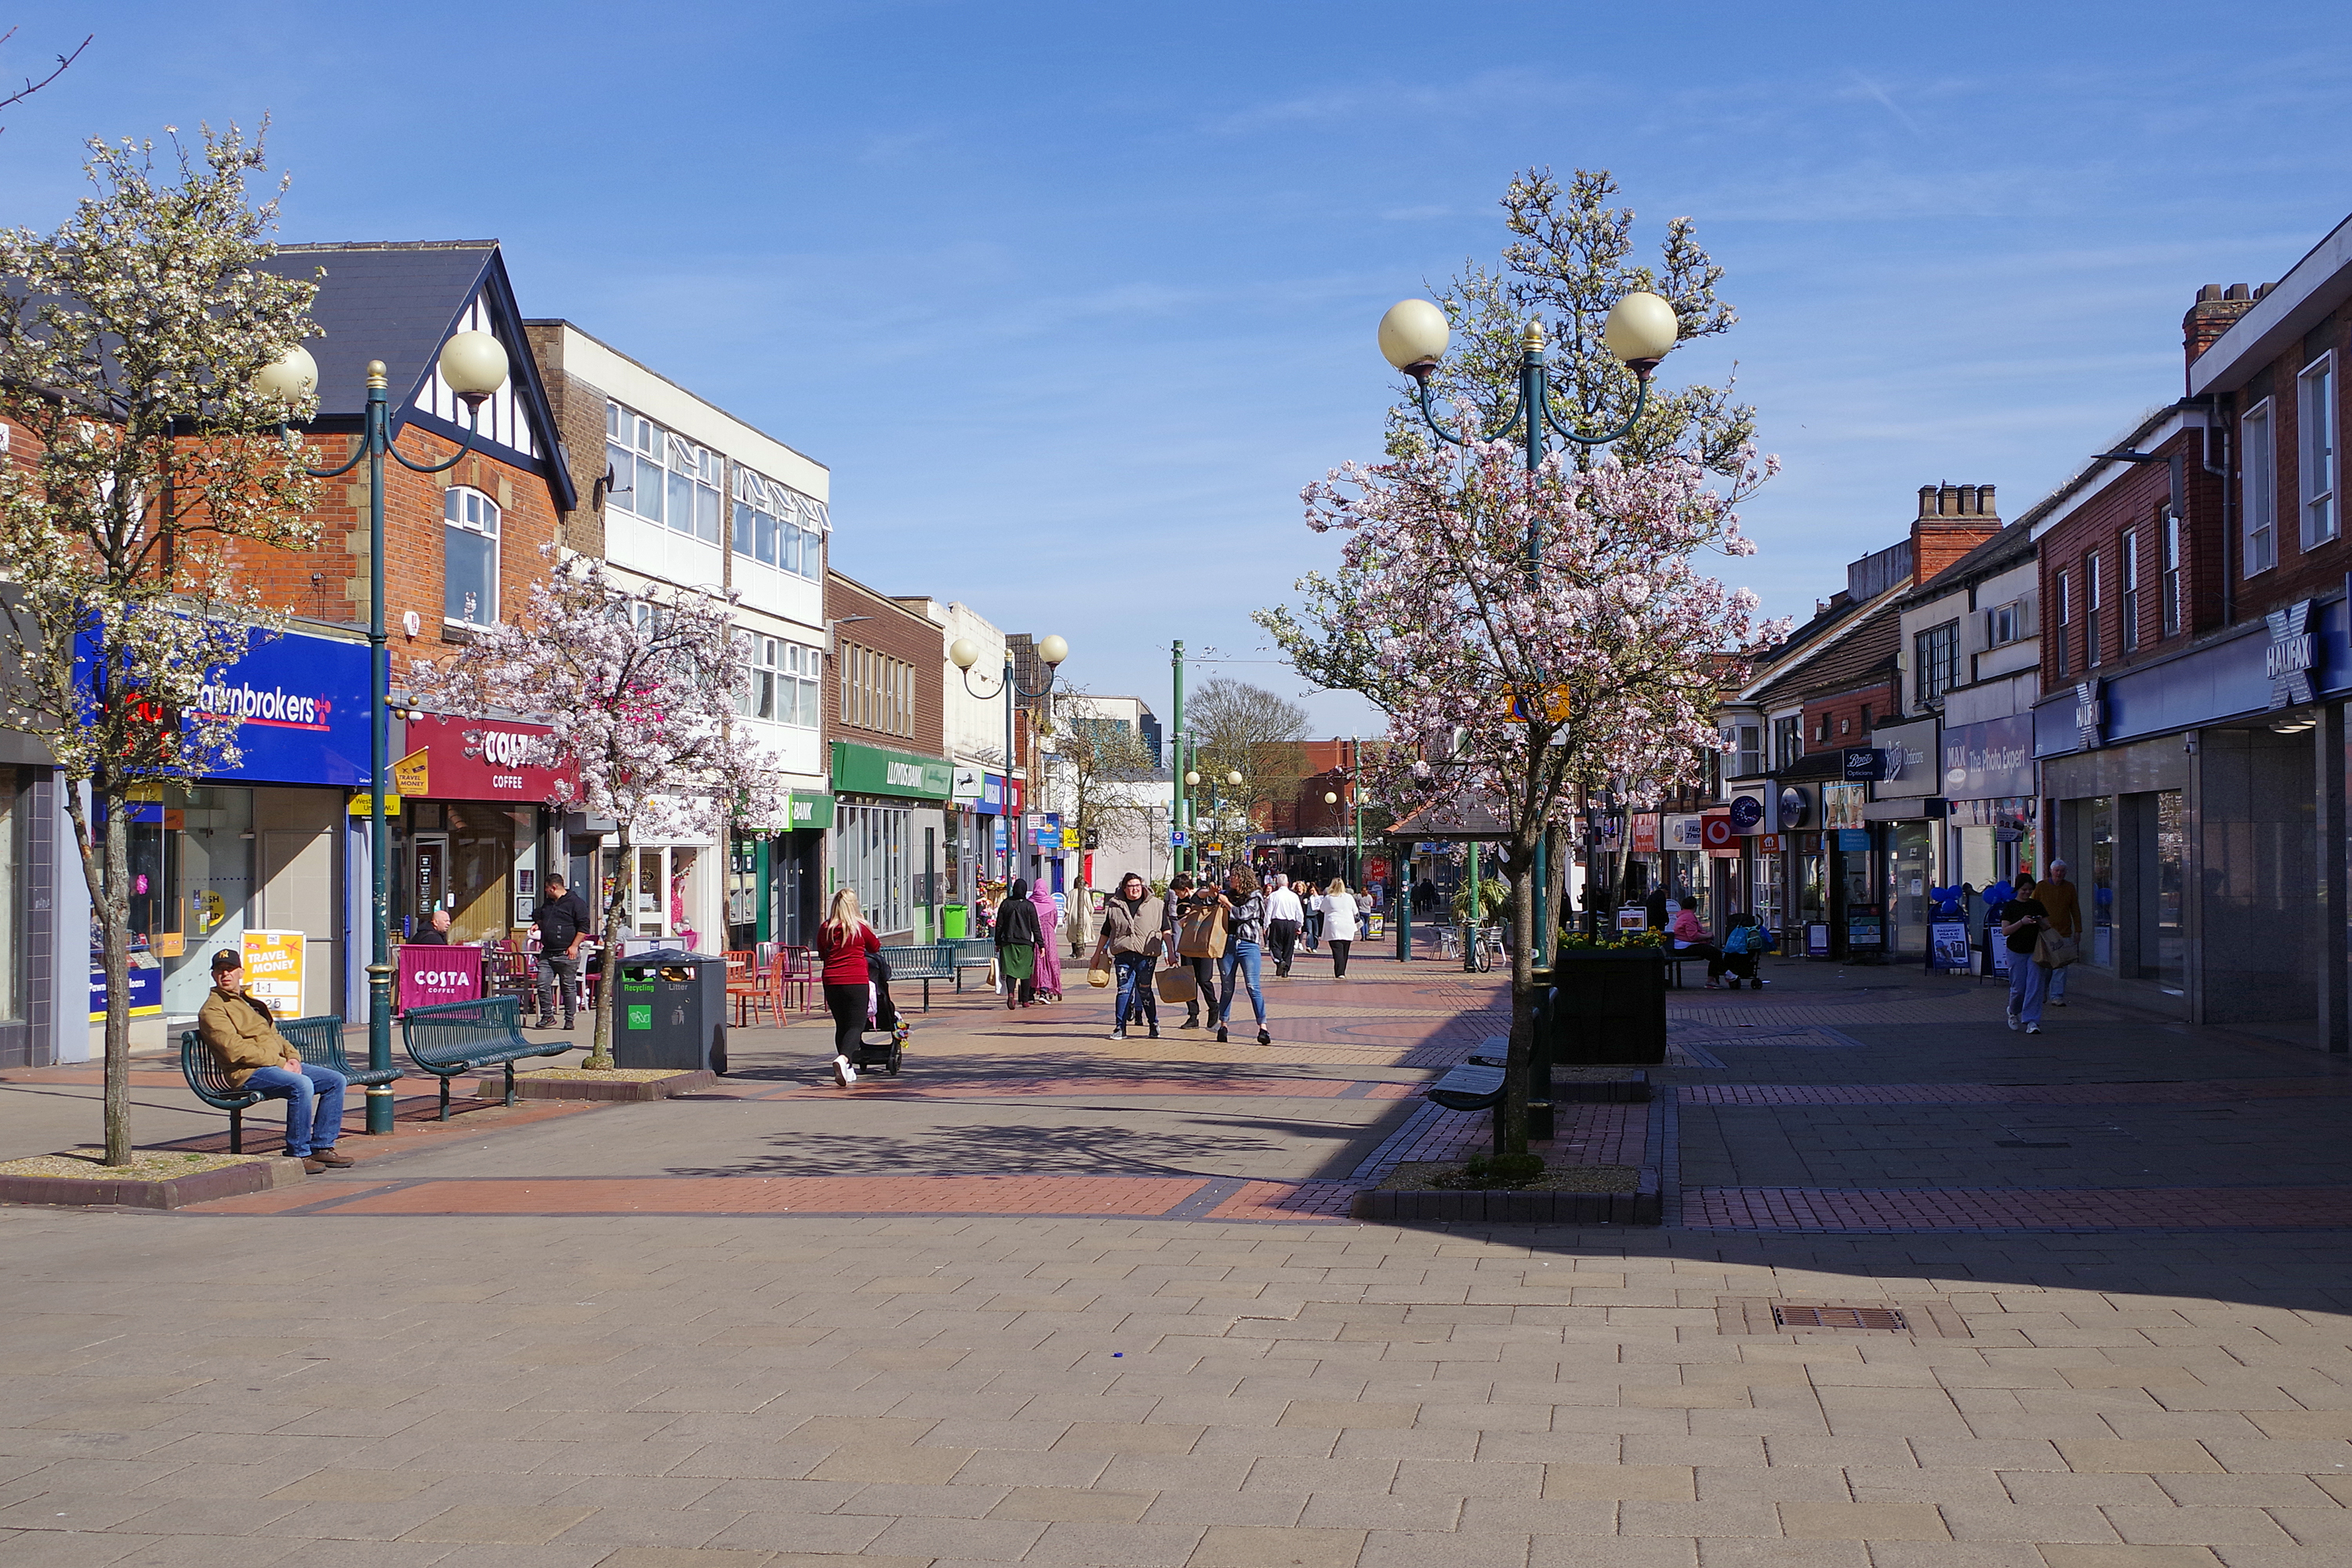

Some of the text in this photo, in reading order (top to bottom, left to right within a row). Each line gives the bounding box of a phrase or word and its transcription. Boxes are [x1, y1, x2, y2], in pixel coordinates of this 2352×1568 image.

[2266, 634, 2312, 677] HALIFAX
[2075, 702, 2100, 728] HALIFAX
[1846, 753, 1874, 768] Boots
[1904, 748, 1924, 769] Opticians
[1947, 746, 1966, 768] MAX
[1969, 744, 2026, 775] The Photo Expert
[492, 775, 523, 789] COFFEE
[887, 760, 924, 788] LLOYDS BANK
[793, 802, 813, 821] BANK
[194, 913, 220, 921] GLD
[248, 950, 288, 964] TRAVEL
[252, 960, 295, 974] MONEY
[414, 971, 470, 987] COSTA
[623, 984, 655, 993] Recycling
